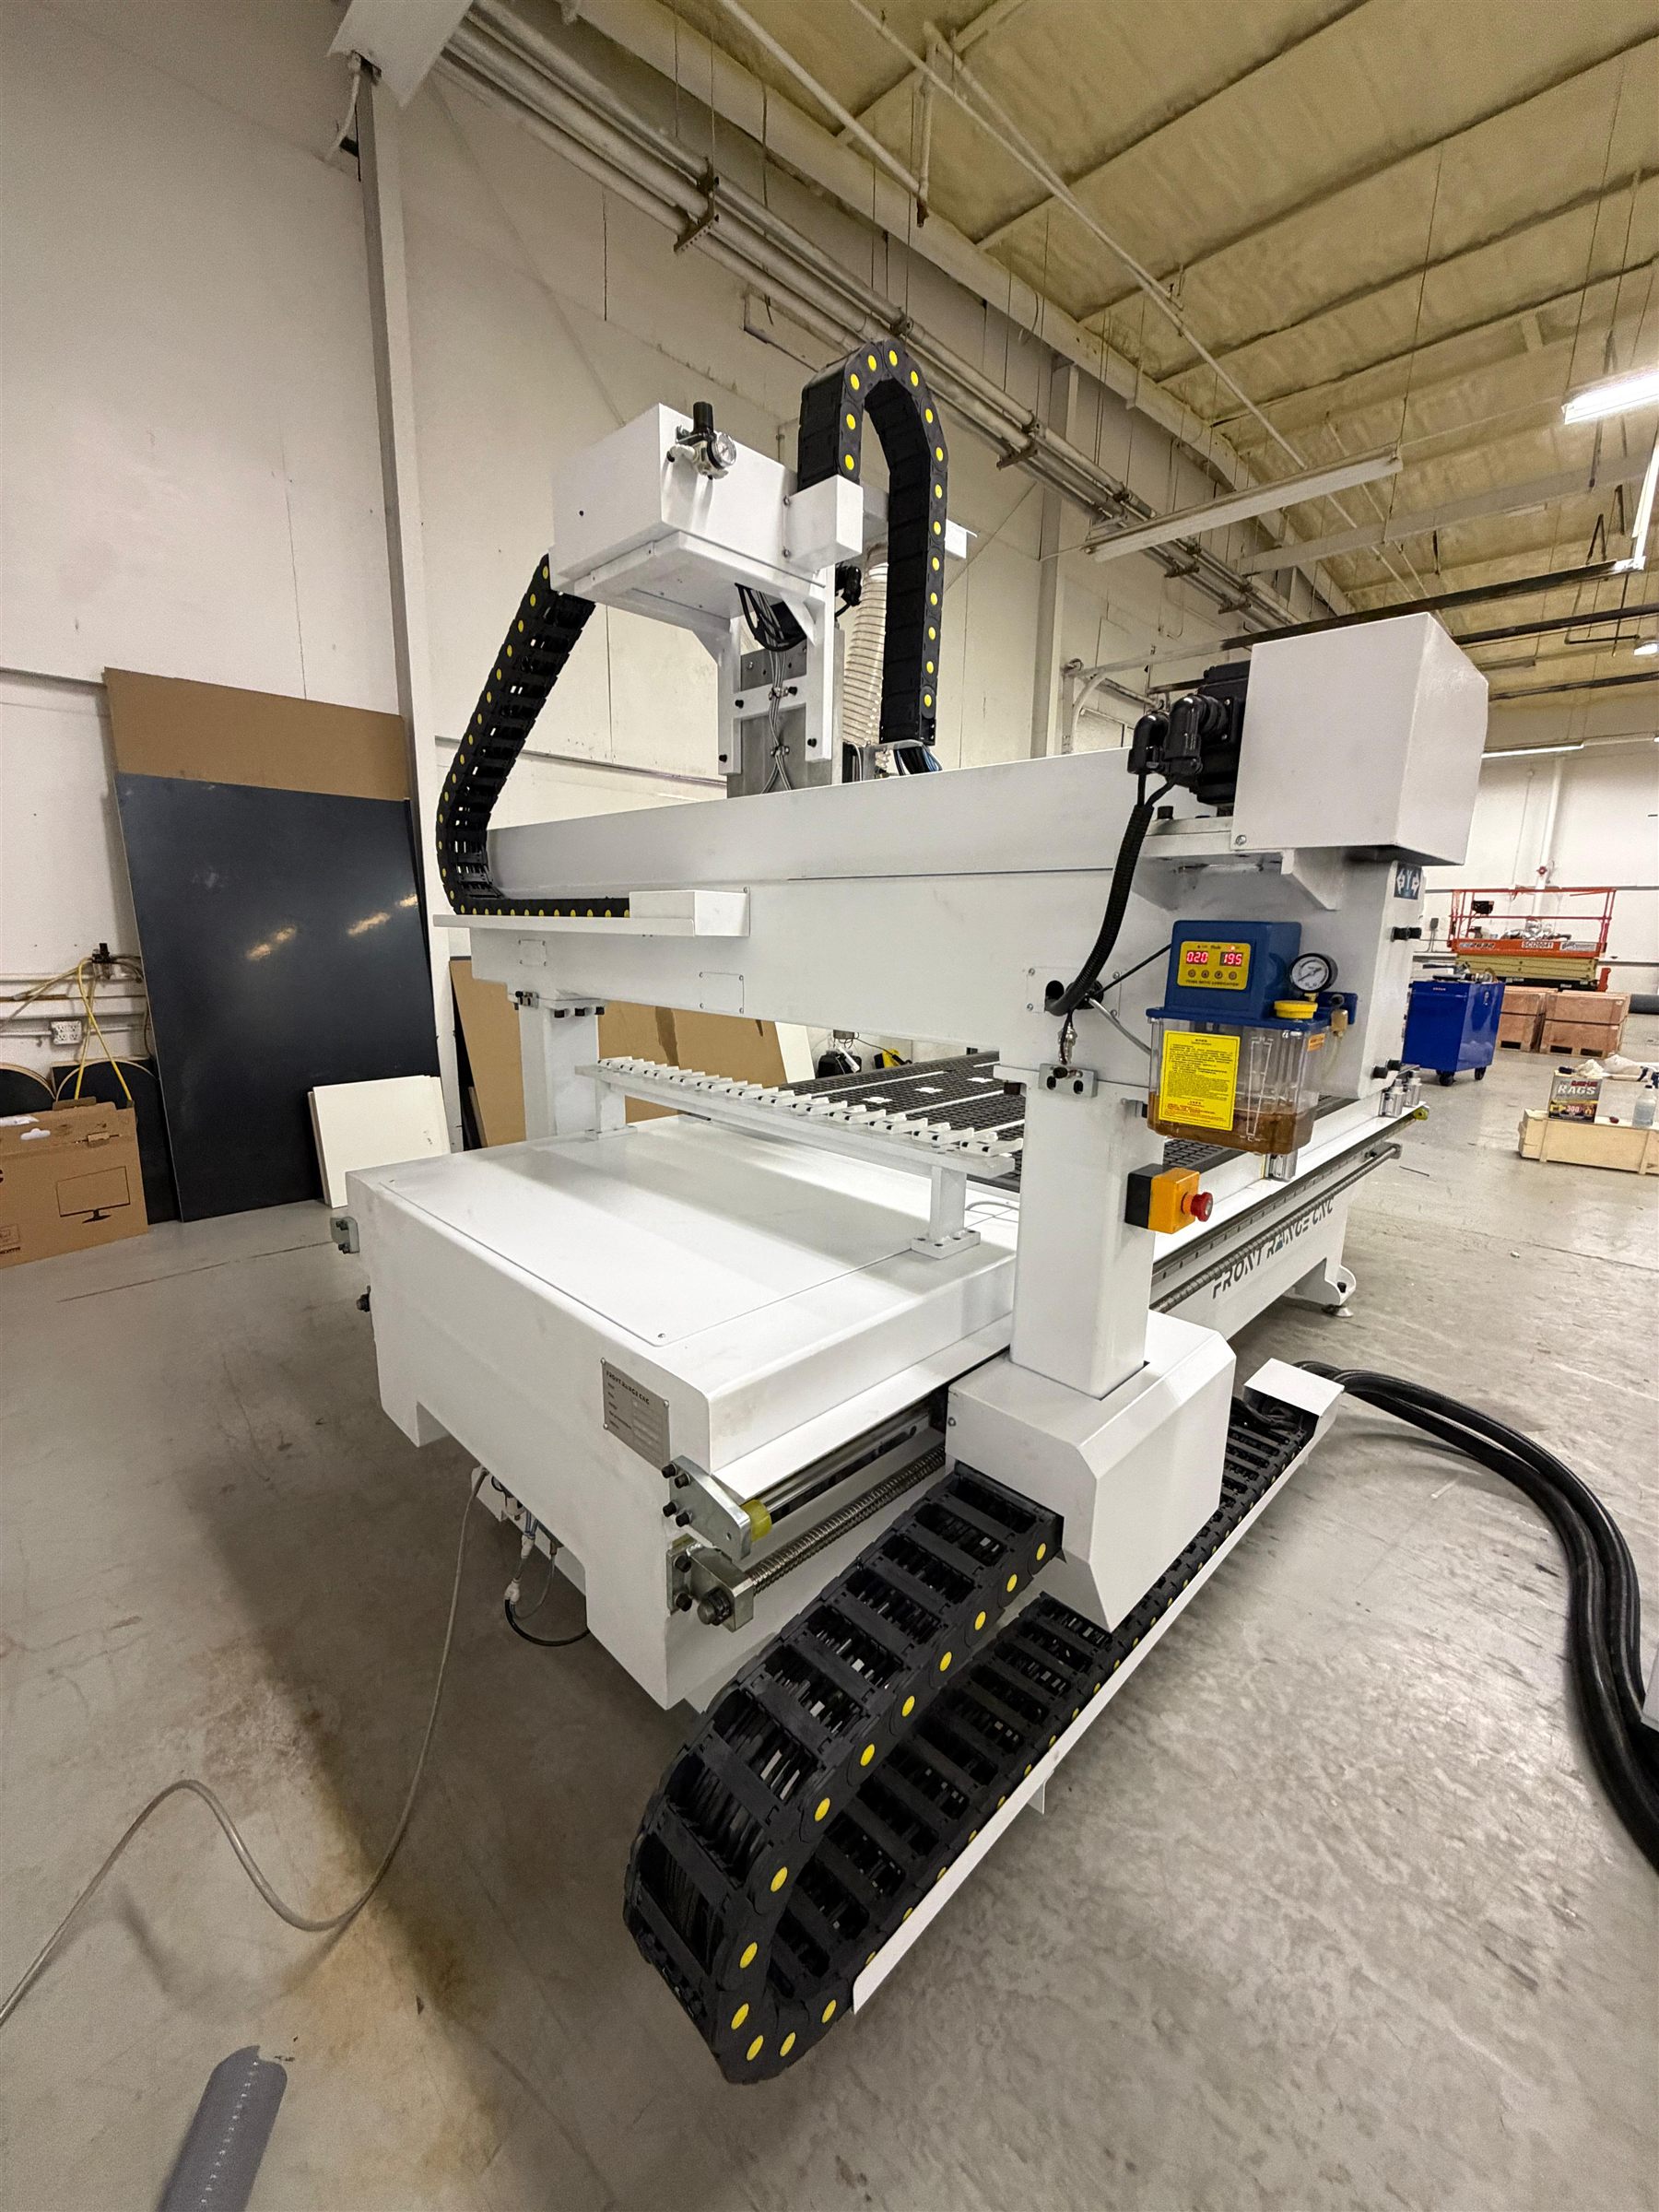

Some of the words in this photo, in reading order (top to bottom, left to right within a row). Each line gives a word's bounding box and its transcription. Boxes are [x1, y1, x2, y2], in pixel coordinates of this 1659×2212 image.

[1186, 951, 1208, 963] 020
[1223, 953, 1242, 965] 195
[1558, 1085, 1596, 1095] RAGS
[1212, 1247, 1263, 1299] FRONT
[1266, 1217, 1310, 1258] RANGE
[1312, 1200, 1334, 1224] CNC
